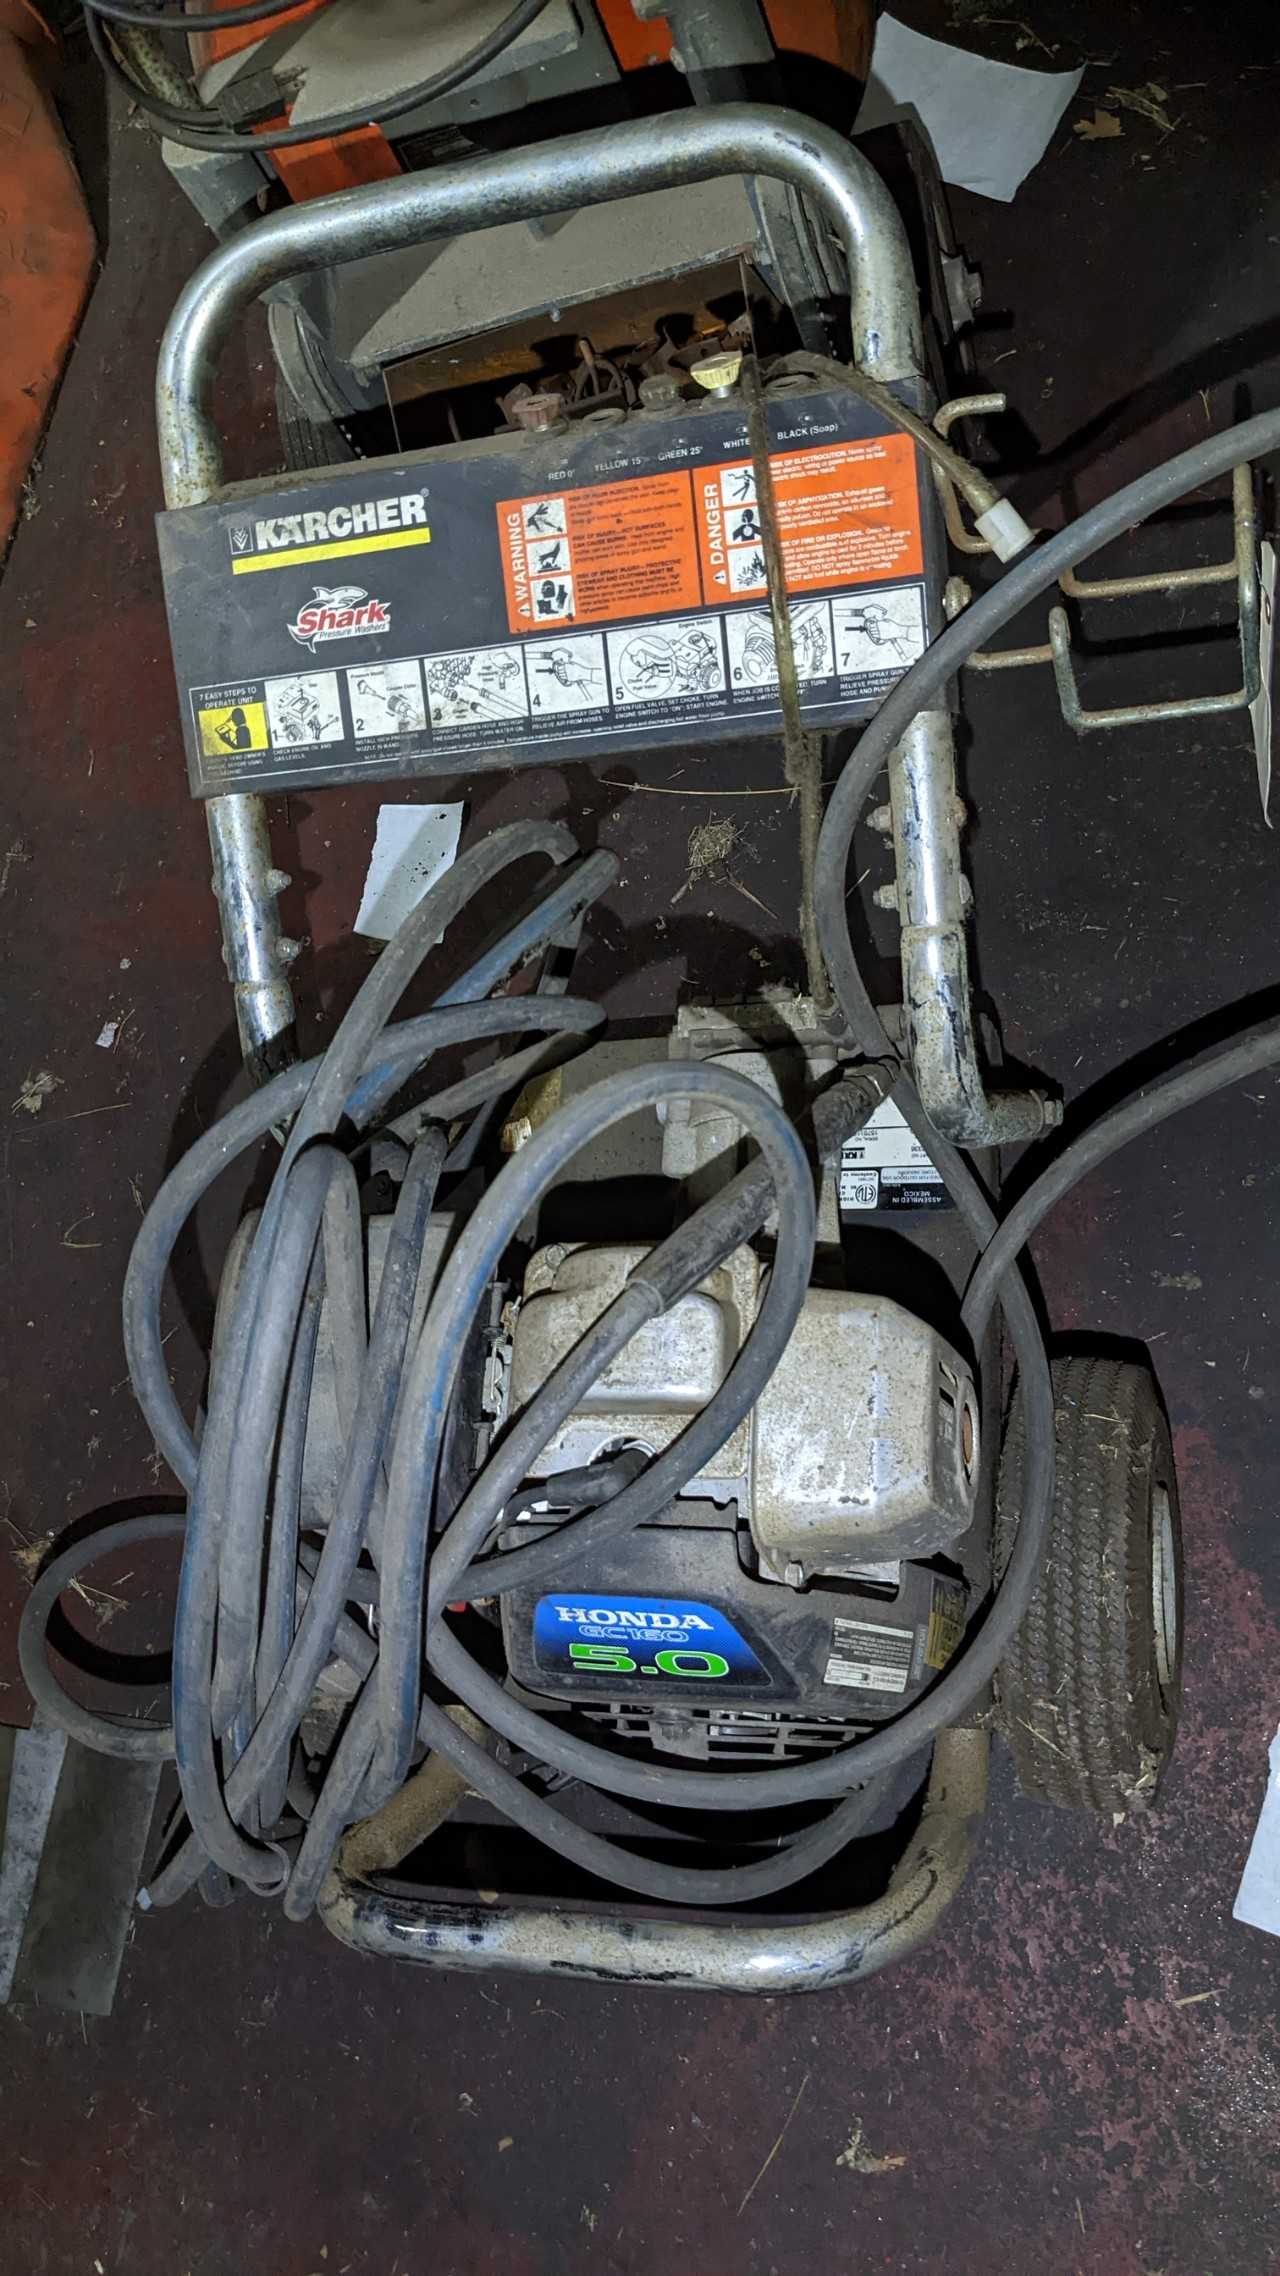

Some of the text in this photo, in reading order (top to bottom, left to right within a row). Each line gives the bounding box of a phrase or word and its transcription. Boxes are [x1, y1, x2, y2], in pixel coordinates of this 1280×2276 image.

[777, 423, 839, 440] BLACK (Soap)
[723, 438, 750, 449] WHITE
[658, 450, 687, 462] GREEN
[594, 459, 629, 472] YELLOW
[548, 471, 566, 481] RED
[704, 484, 726, 564] DANGER
[507, 512, 528, 601] WARNING
[297, 600, 386, 636] Shark
[354, 622, 387, 635] Washers
[841, 652, 850, 666] 7
[733, 668, 743, 681] 6
[615, 687, 625, 700] 5
[532, 694, 541, 707] 4
[356, 719, 365, 731] 2
[555, 1606, 714, 1630] HONDA
[578, 1624, 690, 1643] GC160
[568, 1643, 730, 1678] 5.0
